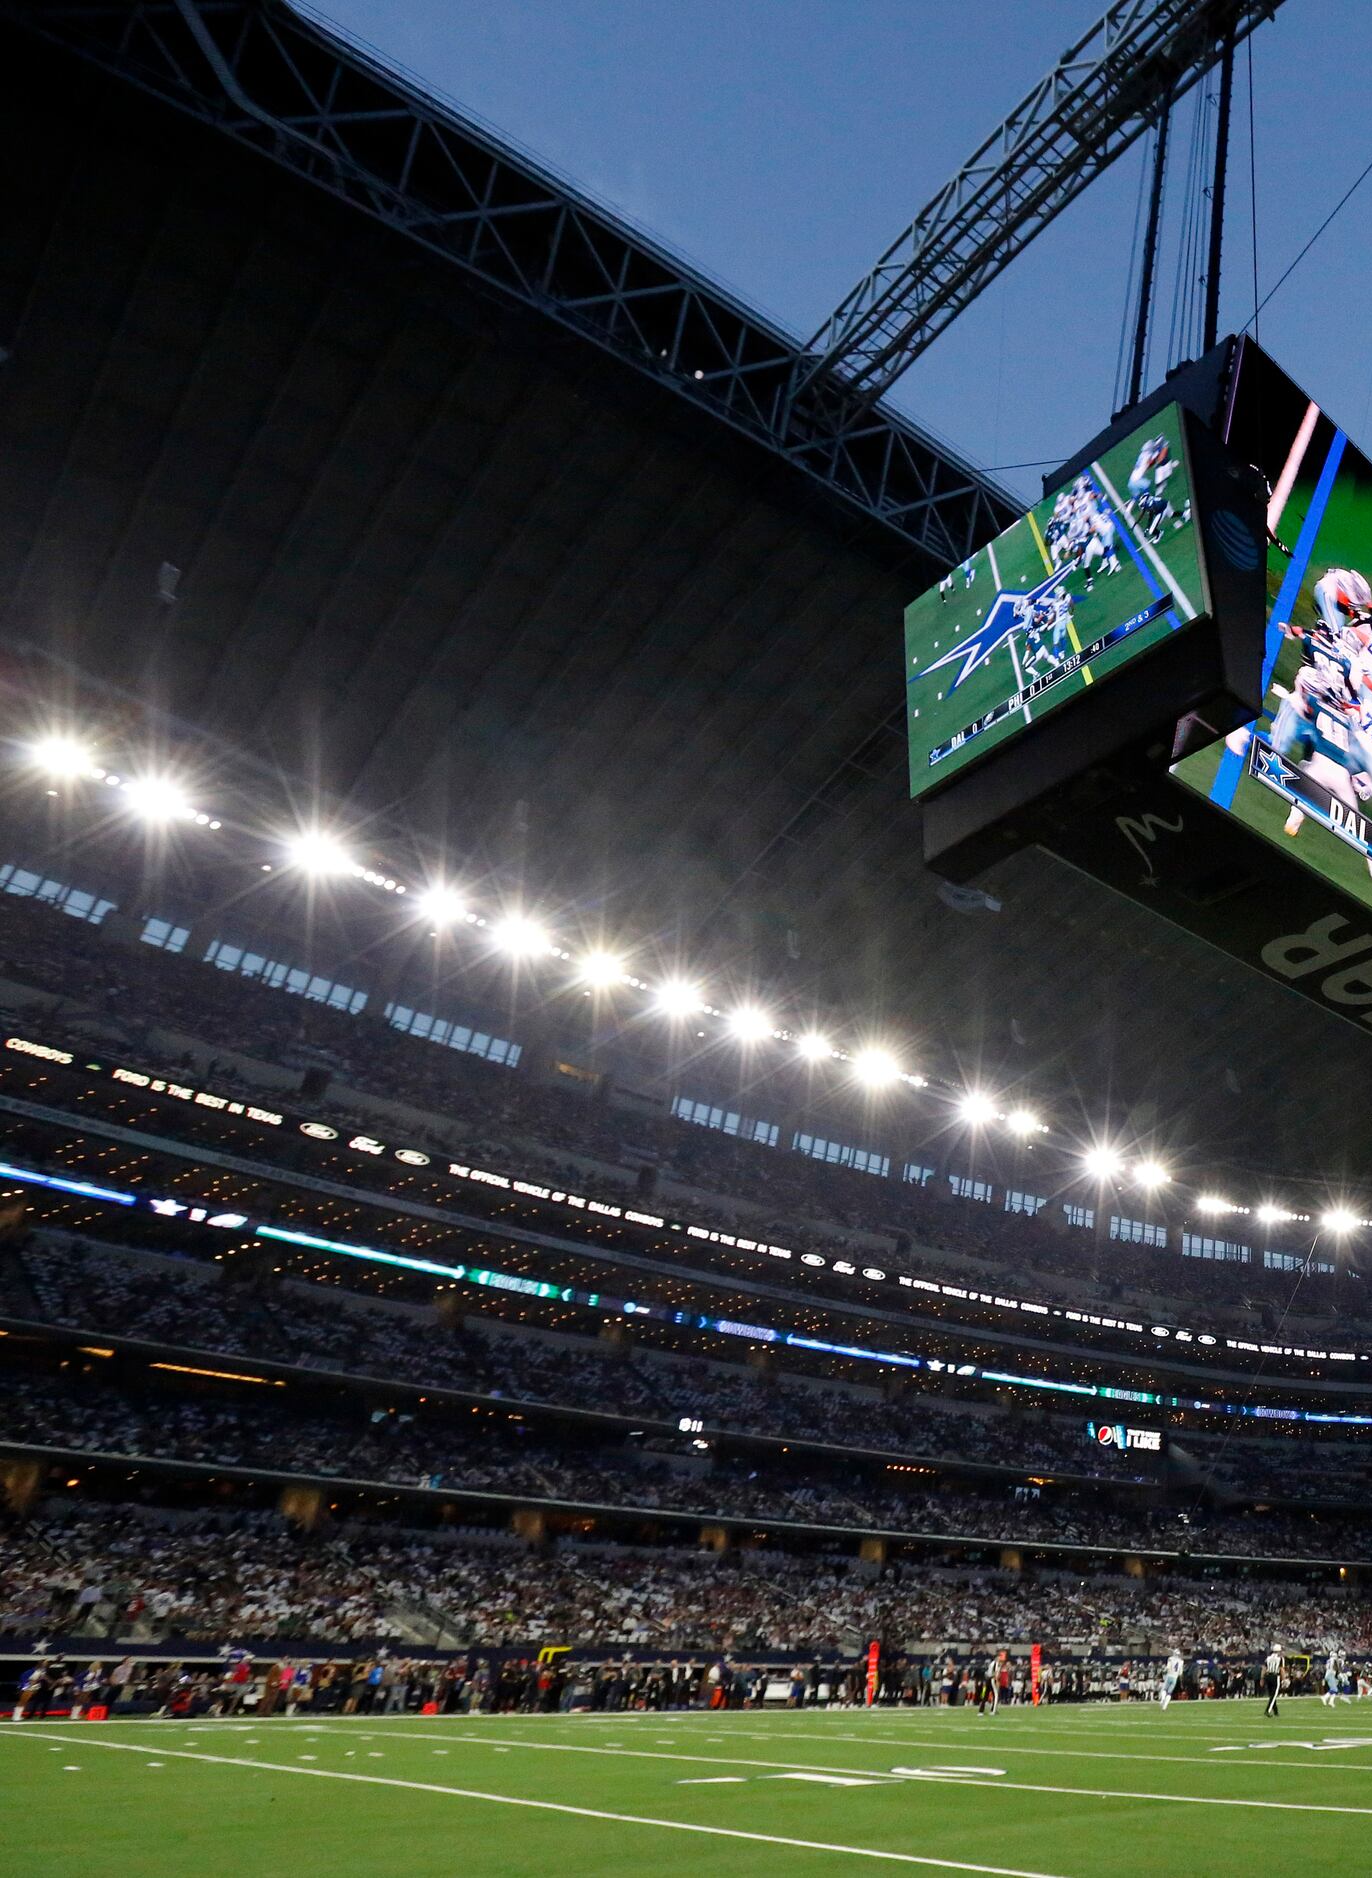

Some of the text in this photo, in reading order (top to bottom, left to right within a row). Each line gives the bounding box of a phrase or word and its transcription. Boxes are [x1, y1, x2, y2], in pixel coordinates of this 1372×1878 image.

[1008, 693, 1023, 710] PHI
[1029, 685, 1035, 697] 0
[1062, 655, 1081, 673] 13:12
[951, 723, 978, 749] DAL 0
[1330, 797, 1369, 846] DAL
[5, 1038, 74, 1064] COWBOYS
[112, 1068, 283, 1125] FORD IS THE BEST IN TEXAS
[1133, 1436, 1161, 1451] LIKE
